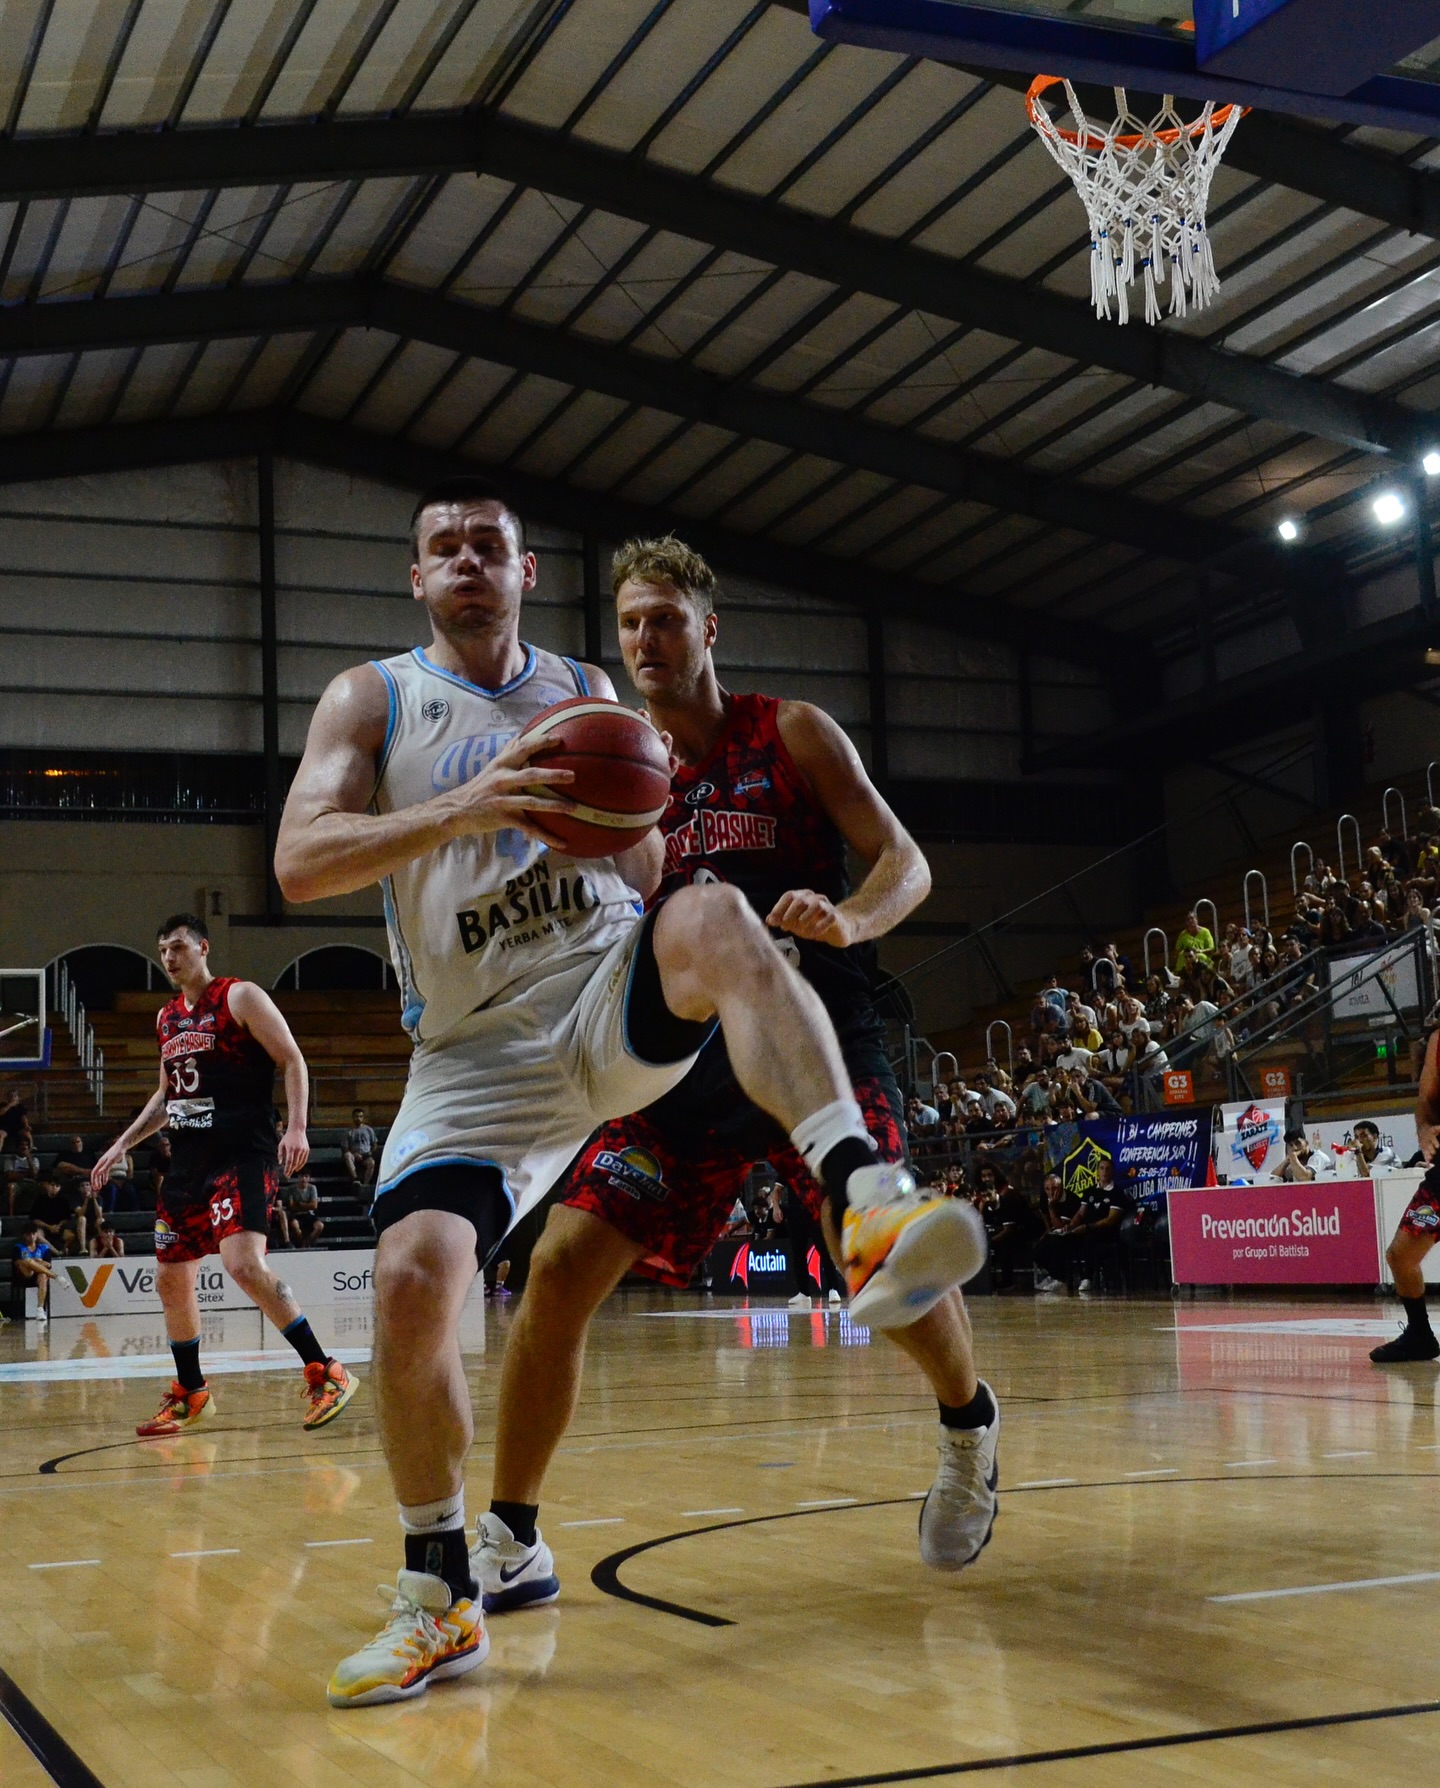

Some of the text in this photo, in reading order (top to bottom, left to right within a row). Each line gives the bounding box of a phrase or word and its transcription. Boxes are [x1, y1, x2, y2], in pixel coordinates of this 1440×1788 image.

[700, 808, 777, 854] BASKET
[456, 874, 601, 954] BASILIO
[499, 930, 540, 951] YERBA
[1168, 1075, 1188, 1088] G3
[1265, 1072, 1286, 1086] G2
[1147, 1119, 1198, 1142] CAMPEONES
[1240, 1122, 1268, 1141] ZARATE
[1119, 1143, 1170, 1163] CONFERENCIA
[1169, 1144, 1186, 1161] SUR
[1138, 1180, 1155, 1198] LIGA
[211, 1198, 234, 1226] 33
[1201, 1206, 1341, 1239] Prevención Salud
[748, 1248, 786, 1272] Acutain
[1233, 1244, 1309, 1260] por Grupo Di Battista
[197, 1293, 224, 1303] Sitex
